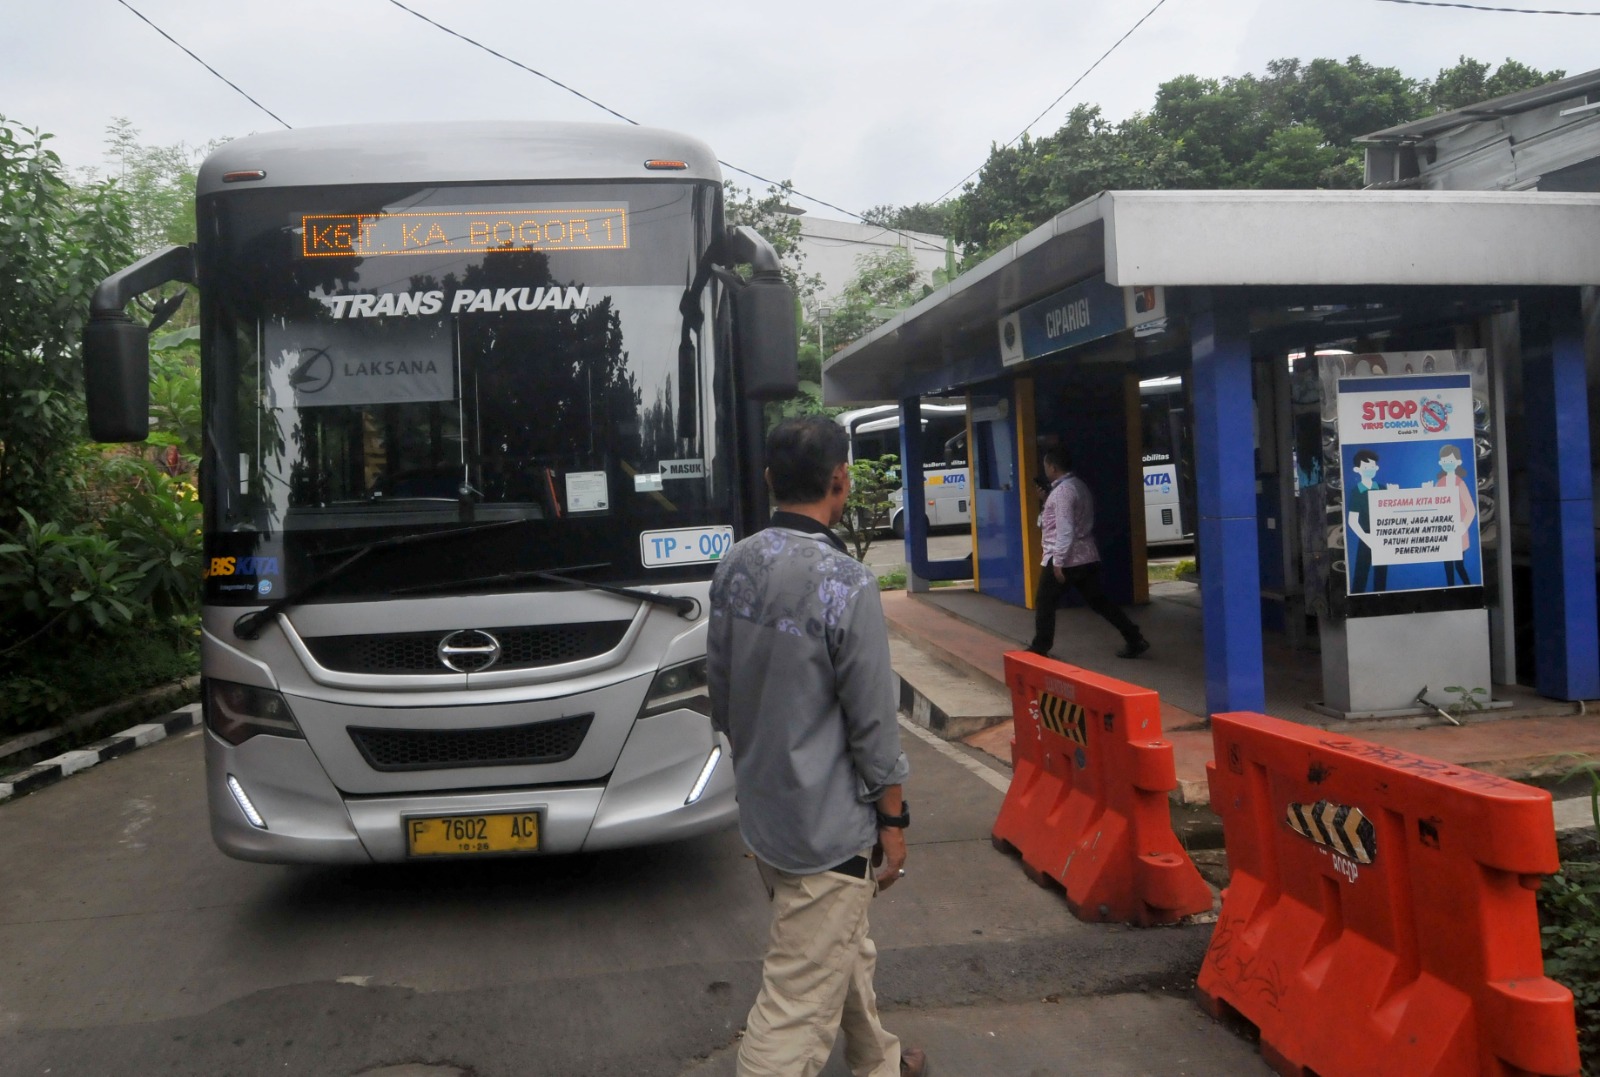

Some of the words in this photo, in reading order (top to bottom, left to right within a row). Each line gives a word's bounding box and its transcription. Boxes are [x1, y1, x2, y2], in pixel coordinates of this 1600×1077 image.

[470, 218, 591, 245] BOGOR
[602, 217, 612, 242] 1
[332, 291, 444, 319] TRANS
[450, 286, 590, 313] PAKUAN
[1045, 298, 1091, 338] CIPARIGI
[344, 359, 437, 377] LAKSANA
[1362, 400, 1418, 421] STOP
[1361, 422, 1384, 430] VIRUS
[1384, 420, 1419, 429] CORONA
[1142, 453, 1170, 462] obilitas
[670, 464, 702, 474] MASUK
[1378, 498, 1413, 507] BERSAMA
[1416, 497, 1433, 505] KITA
[1435, 496, 1451, 504] BISA
[1377, 518, 1409, 526] DISIPLIN,
[1411, 516, 1429, 524] JAGA
[1431, 515, 1454, 523] JARAK,
[1376, 528, 1420, 536] TINGKATKAN
[1383, 538, 1409, 546] PATUHI
[1411, 535, 1448, 544] HIMBAUAN
[651, 538, 677, 559] TP
[1395, 545, 1440, 555] PEMERINTAH
[413, 822, 424, 842] F
[442, 818, 487, 840] 7602
[511, 816, 533, 838] AC
